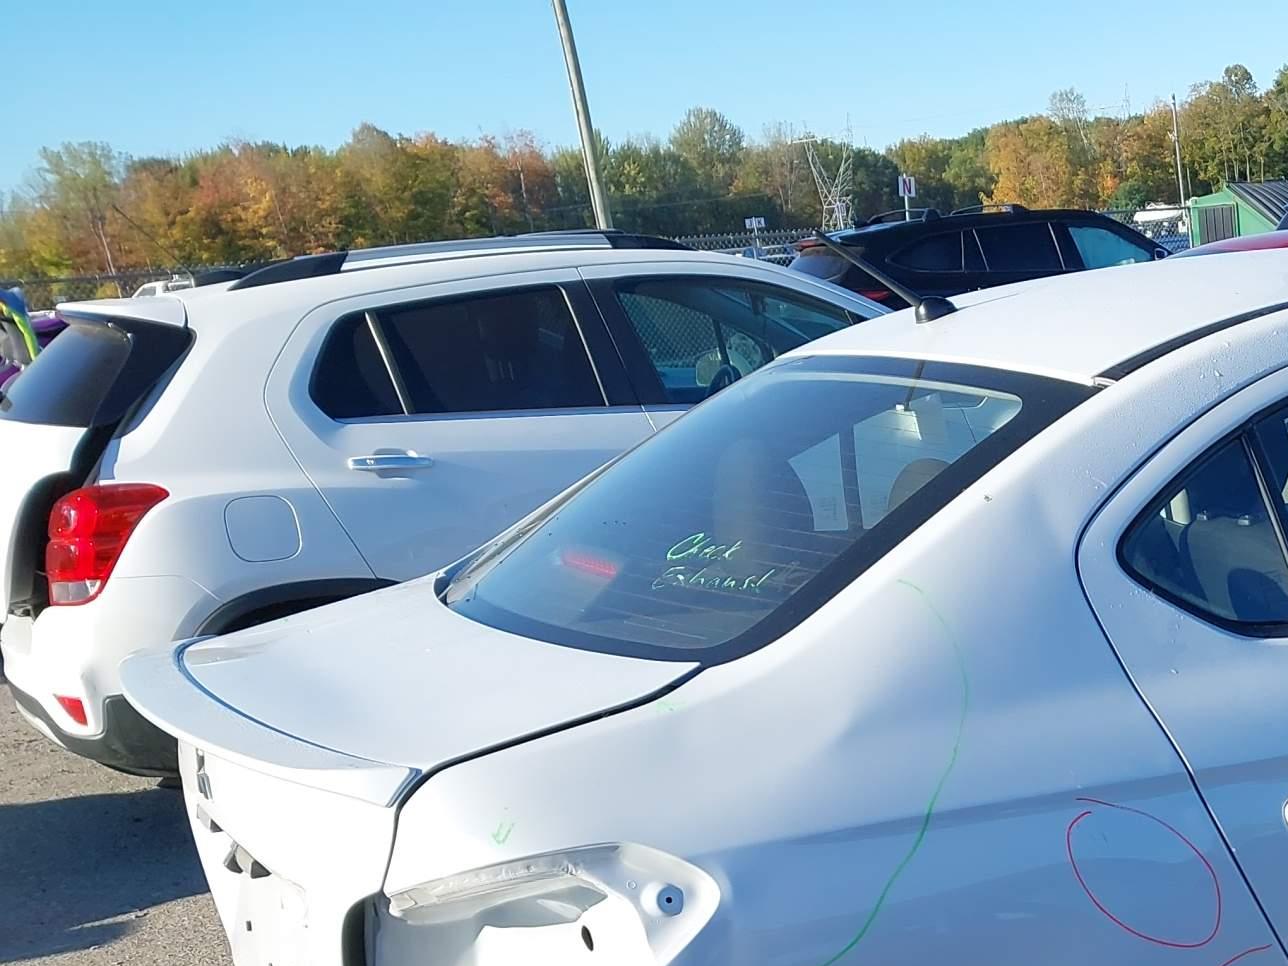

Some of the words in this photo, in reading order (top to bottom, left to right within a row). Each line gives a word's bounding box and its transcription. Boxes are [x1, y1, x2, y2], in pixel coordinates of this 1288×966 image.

[902, 177, 912, 195] N
[667, 532, 743, 560] Check
[651, 566, 776, 594] Exhaust
